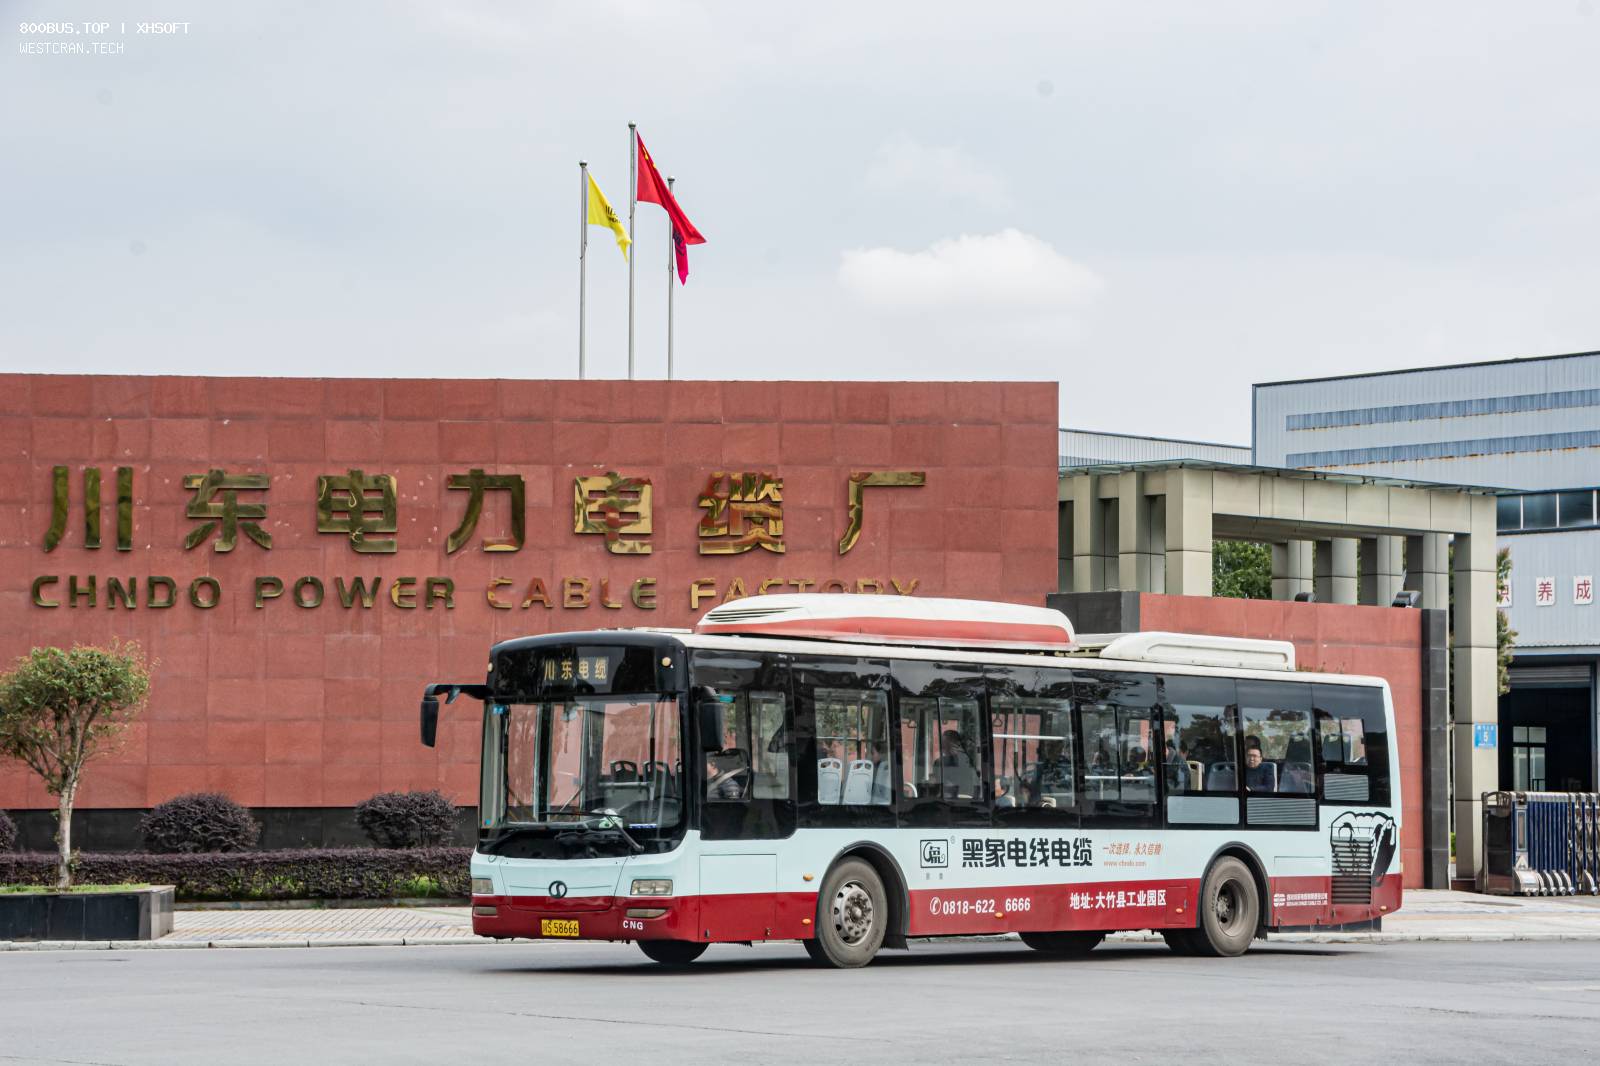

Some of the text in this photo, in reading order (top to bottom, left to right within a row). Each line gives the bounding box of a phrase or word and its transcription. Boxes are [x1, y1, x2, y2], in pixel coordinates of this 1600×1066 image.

[44, 465, 926, 555] 川东电力电缆厂
[31, 575, 221, 609] CHNDO
[255, 576, 456, 609] POWER
[487, 576, 657, 609] CABLE
[544, 657, 608, 681] 川东电缆
[962, 838, 1093, 868] 黑象电线电缆
[942, 897, 1031, 915] 0818-622 6666
[622, 920, 644, 930] CNG
